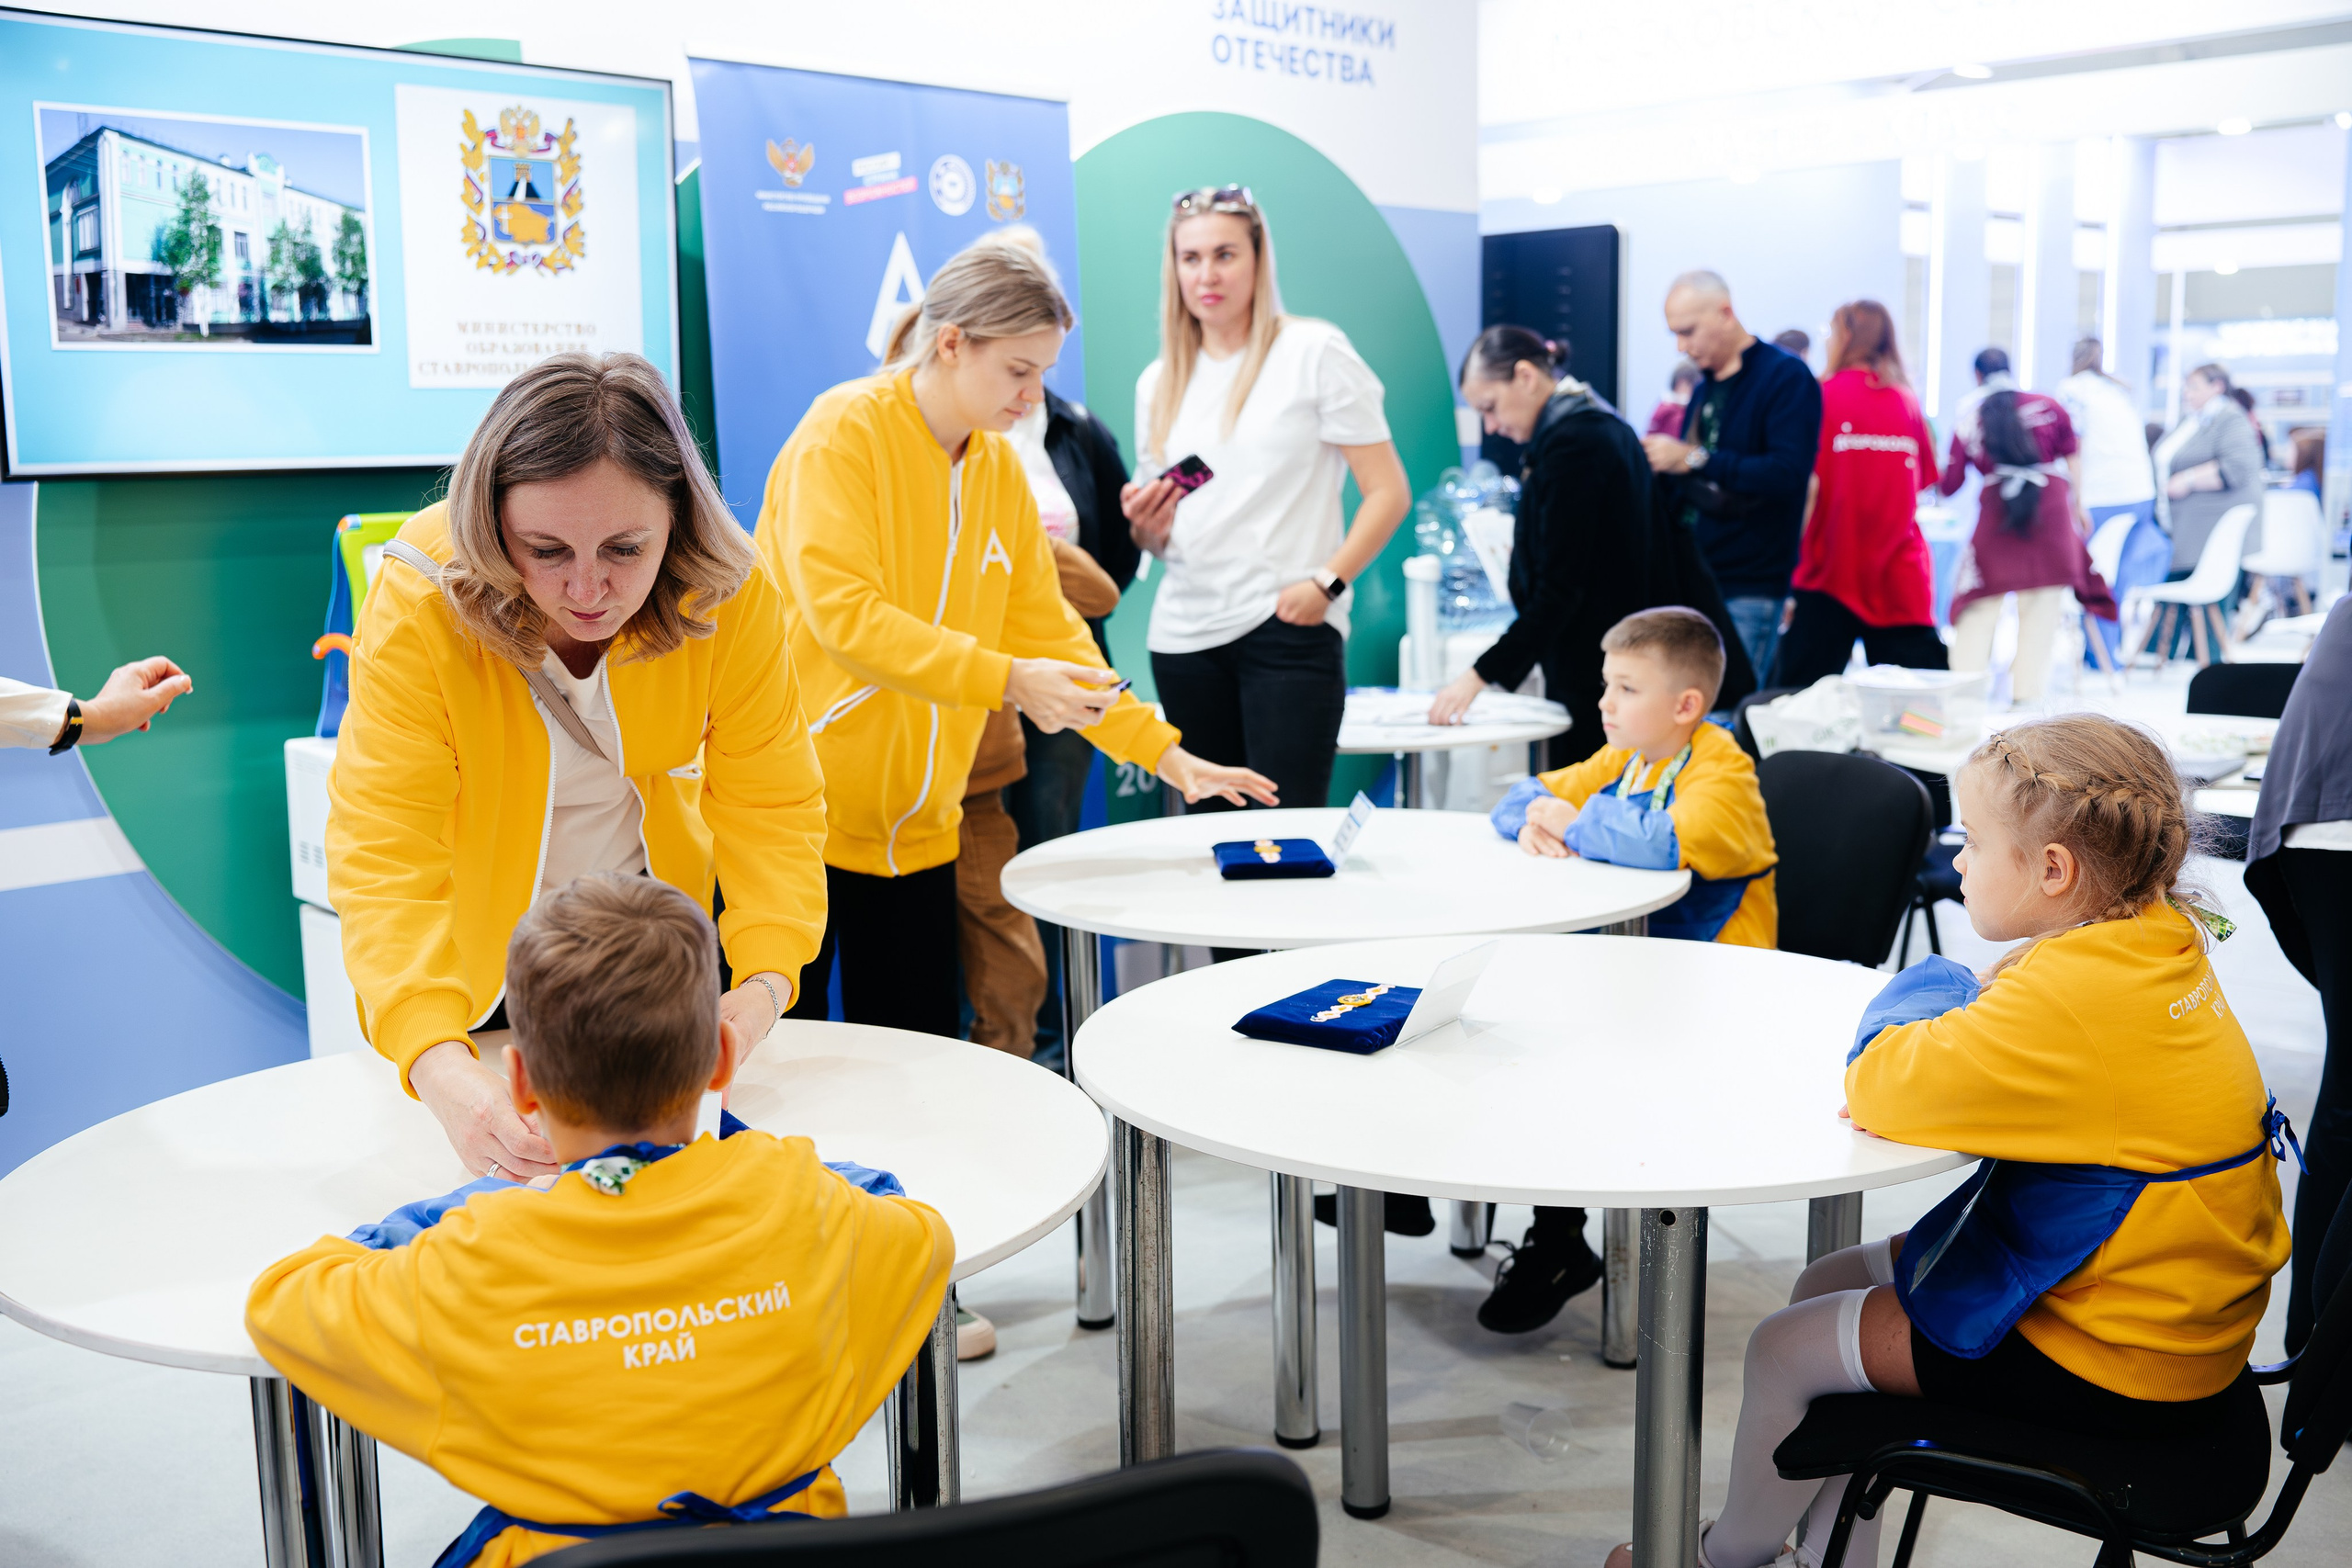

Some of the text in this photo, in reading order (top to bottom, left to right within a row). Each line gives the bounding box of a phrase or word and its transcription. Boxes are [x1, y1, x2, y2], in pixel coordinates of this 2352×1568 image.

[1212, 0, 1396, 49] ЗАЩИТНИКИ
[1212, 33, 1374, 85] ОТЕЧЕСТВА
[514, 1280, 791, 1348] СТАВРОПОЛЬСКИЙ
[623, 1331, 696, 1370] КРАЙ
